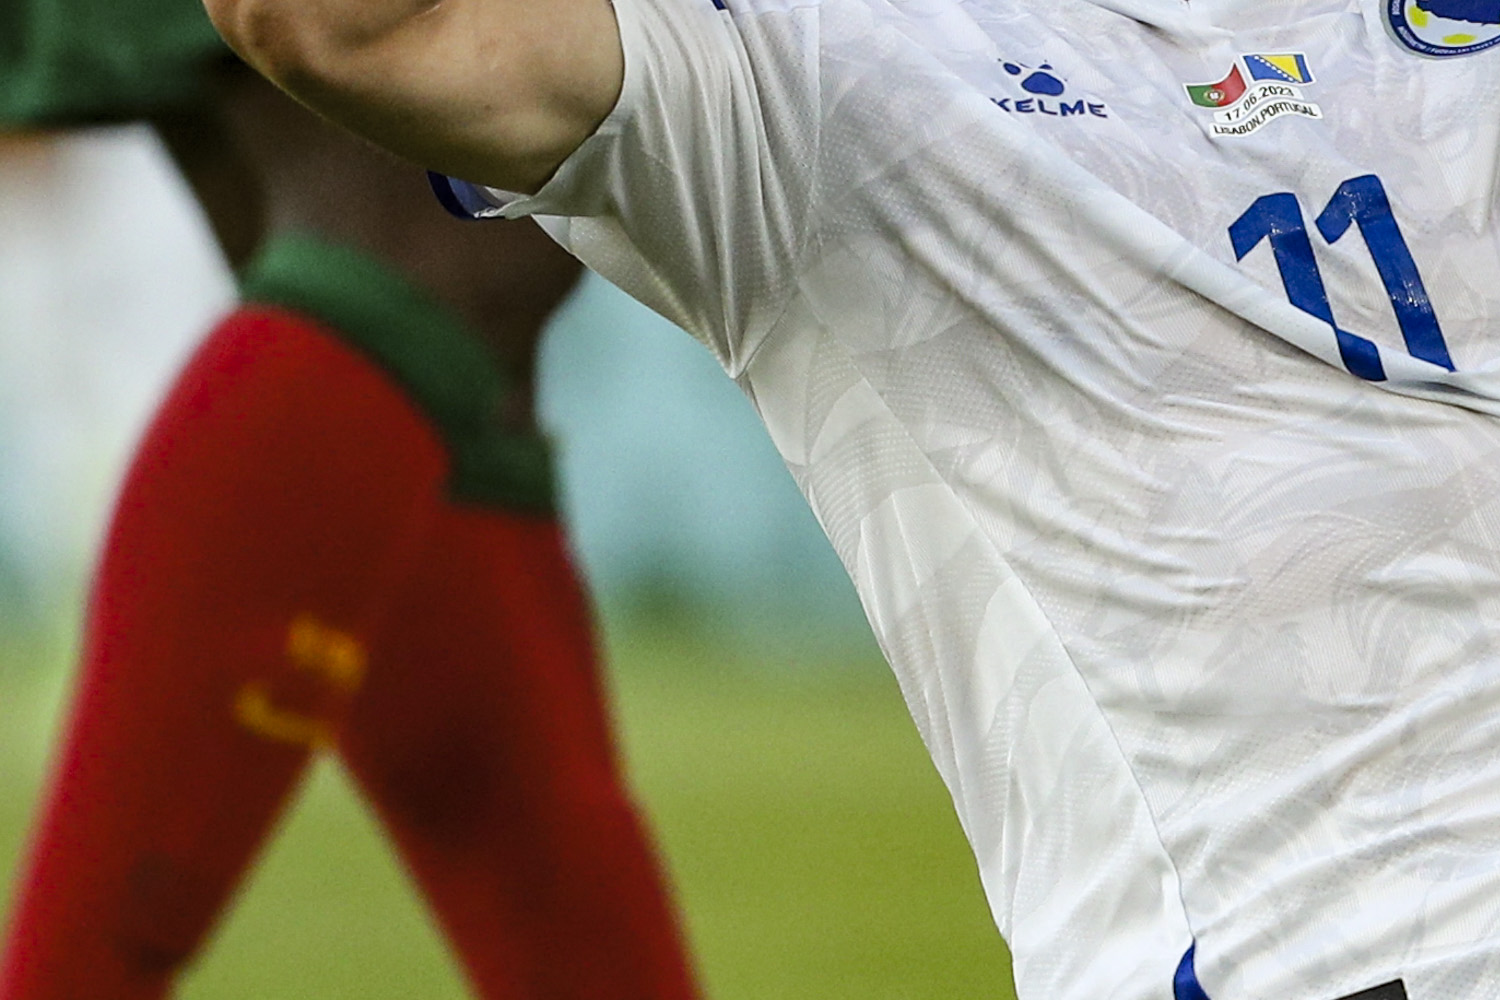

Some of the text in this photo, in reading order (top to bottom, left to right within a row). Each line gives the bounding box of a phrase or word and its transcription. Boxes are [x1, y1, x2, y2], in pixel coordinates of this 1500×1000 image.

[989, 98, 1108, 118] KELME
[1224, 85, 1295, 121] 17.06.2023
[1228, 173, 1457, 382] 11
